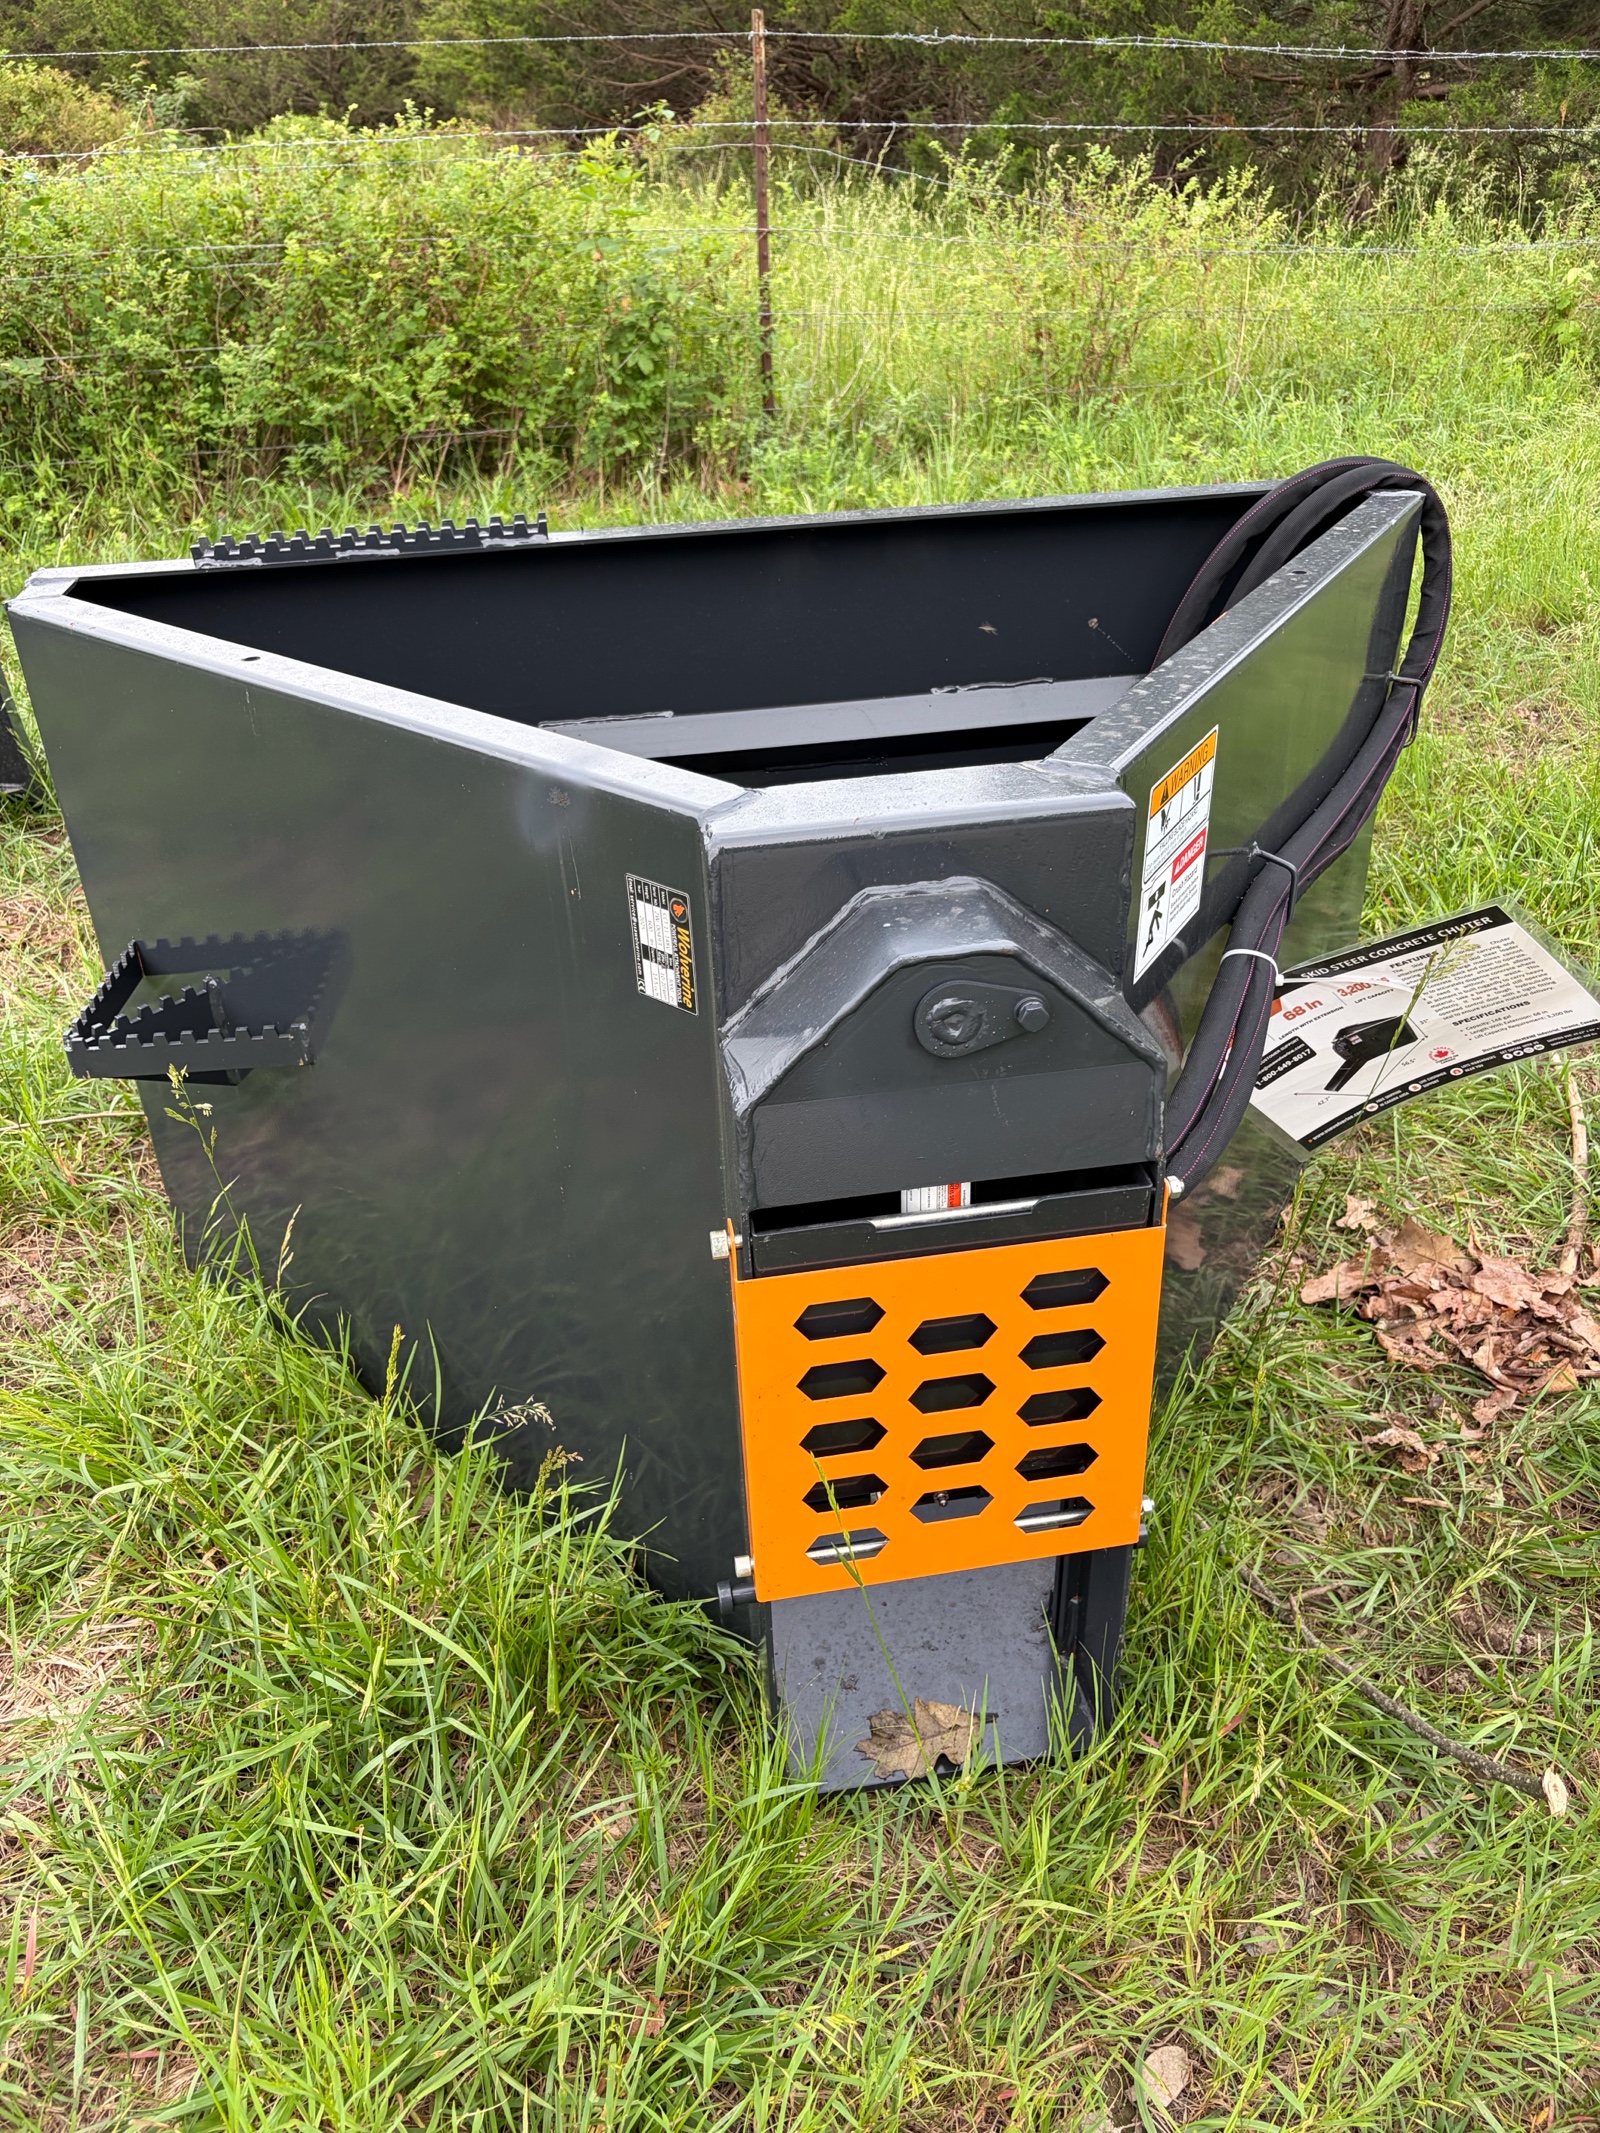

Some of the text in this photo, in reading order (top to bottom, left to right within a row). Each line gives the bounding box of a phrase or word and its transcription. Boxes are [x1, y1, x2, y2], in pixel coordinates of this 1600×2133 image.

[1171, 744, 1209, 794] WARNING
[1179, 836, 1204, 868] DANGER
[1301, 966, 1330, 979] SKID
[1331, 954, 1368, 972] STEER
[1369, 935, 1437, 962] CONCRETE
[1438, 916, 1493, 938] CHUTER
[673, 952, 681, 988] ATTACHMENT
[677, 927, 695, 1008] Wolverine
[1337, 982, 1372, 997] 3,200
[1354, 988, 1394, 1004] LIFT CAPACITY
[1278, 1005, 1344, 1041] LENGTH WITH EXTENSION
[1283, 1005, 1307, 1021] 68
[1452, 1001, 1531, 1025] SPECIFICATIONS
[1255, 1048, 1311, 1086] 1-800-649-8017
